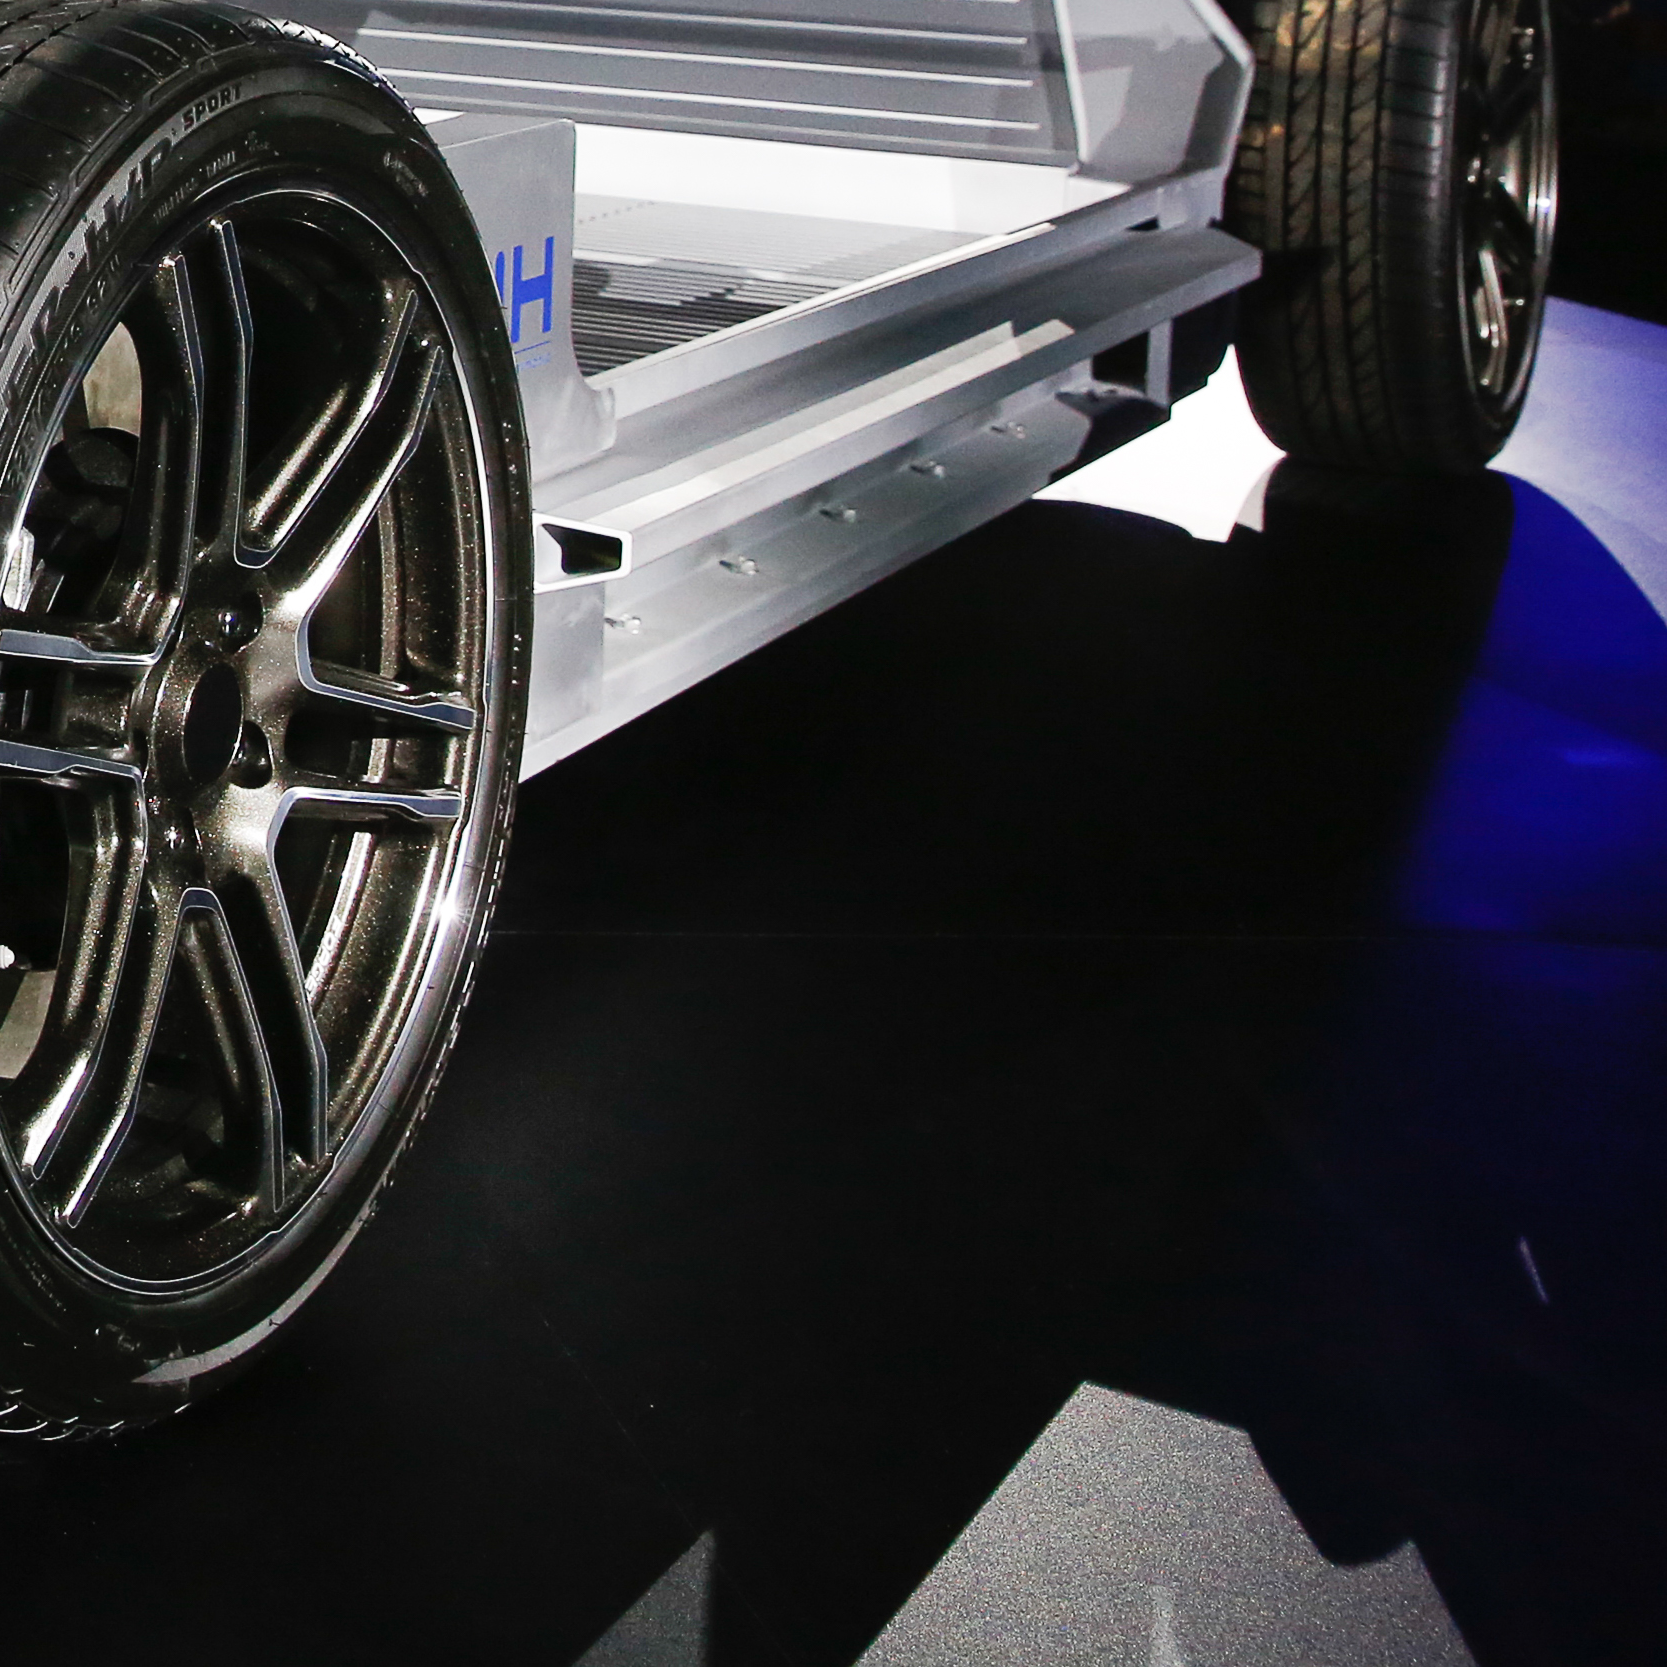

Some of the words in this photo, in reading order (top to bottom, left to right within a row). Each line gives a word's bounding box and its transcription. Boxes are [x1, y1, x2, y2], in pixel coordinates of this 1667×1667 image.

[82, 136, 173, 273] H/P
[180, 84, 243, 131] SPORT
[496, 236, 554, 343] IH
